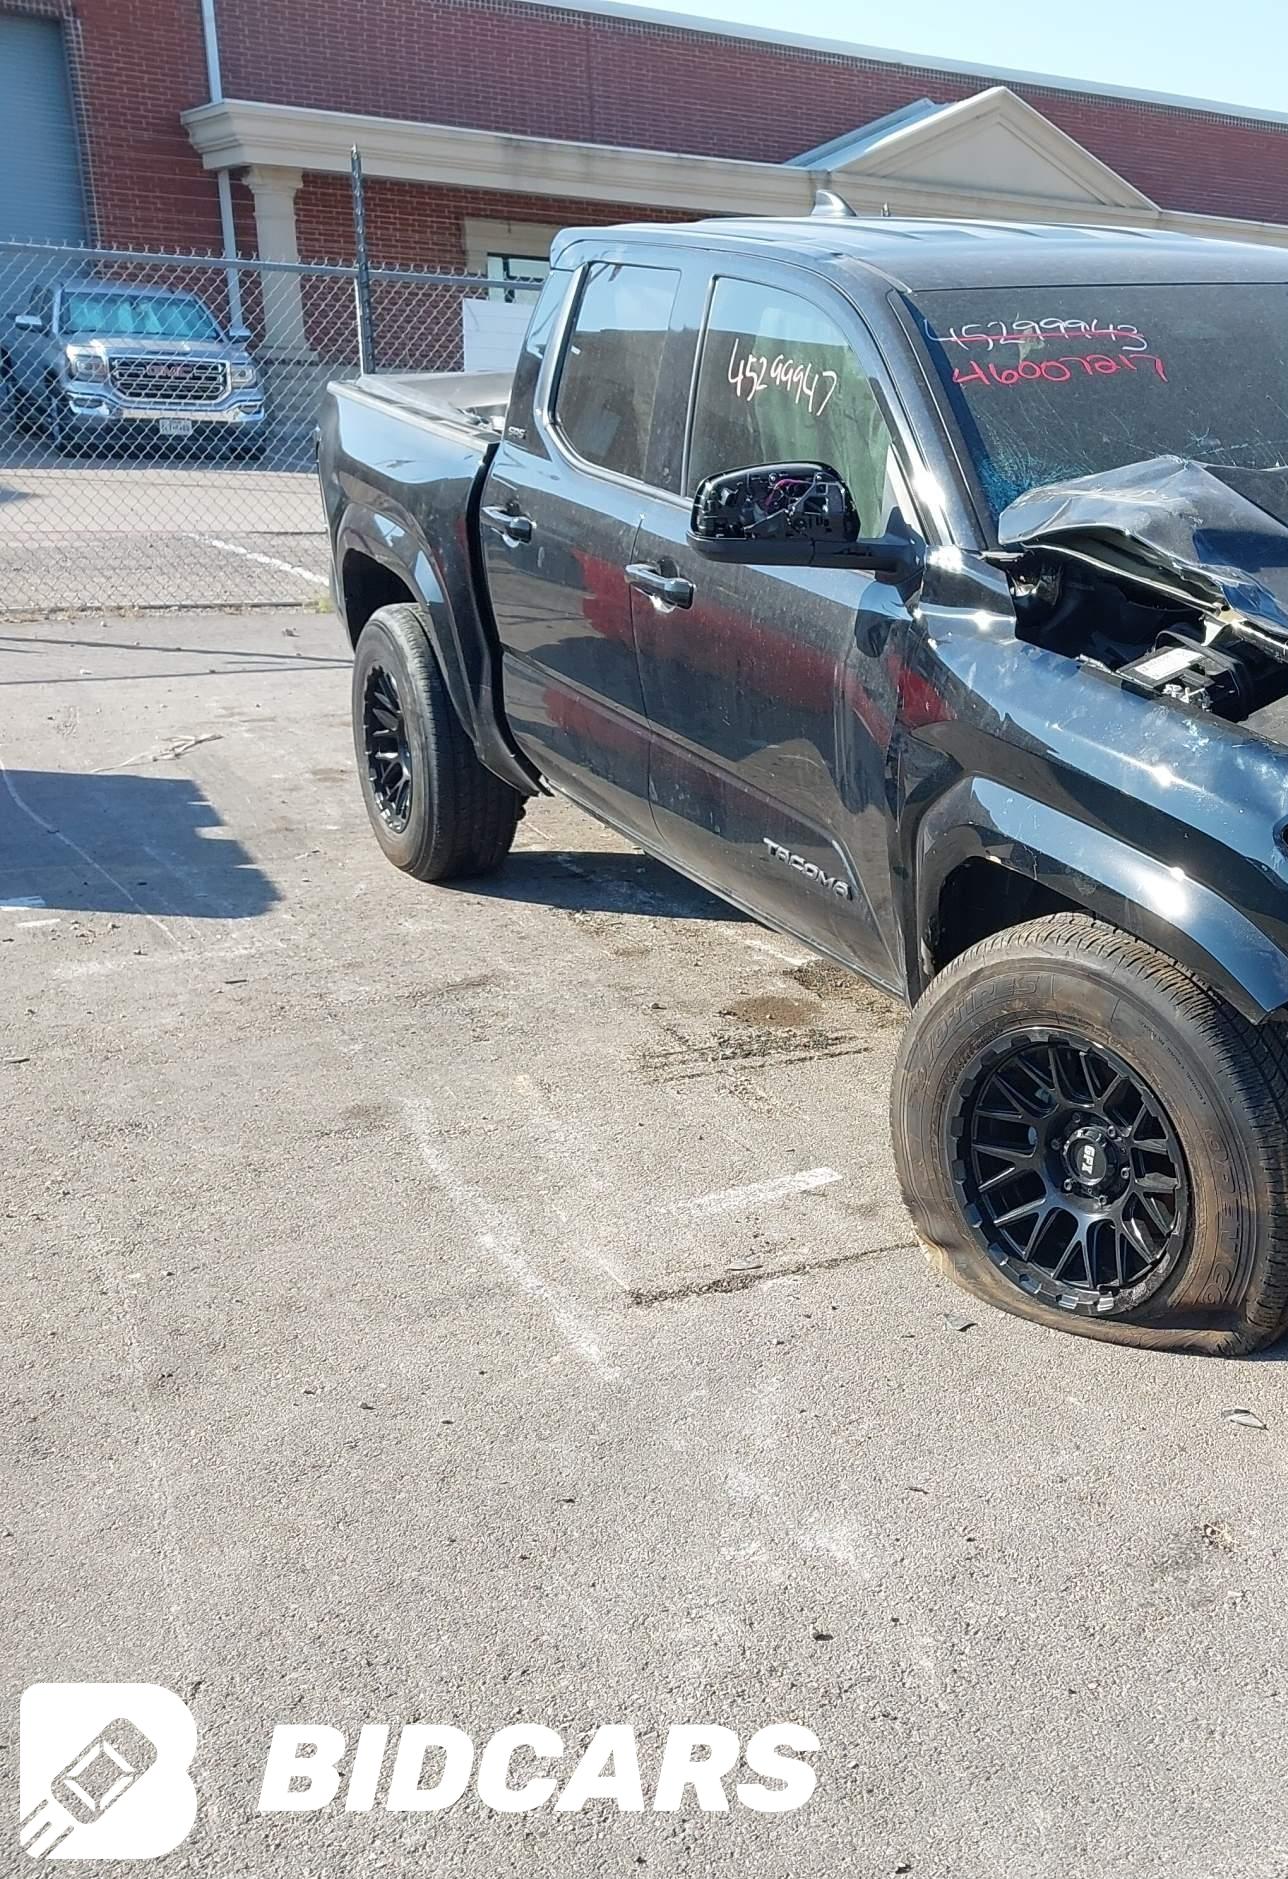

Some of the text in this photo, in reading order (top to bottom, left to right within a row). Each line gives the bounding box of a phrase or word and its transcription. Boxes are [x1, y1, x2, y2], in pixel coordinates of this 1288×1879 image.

[146, 365, 193, 377] GMC
[727, 338, 838, 416] 45299947
[952, 354, 1169, 386] 46007217
[763, 837, 850, 898] TACOMA
